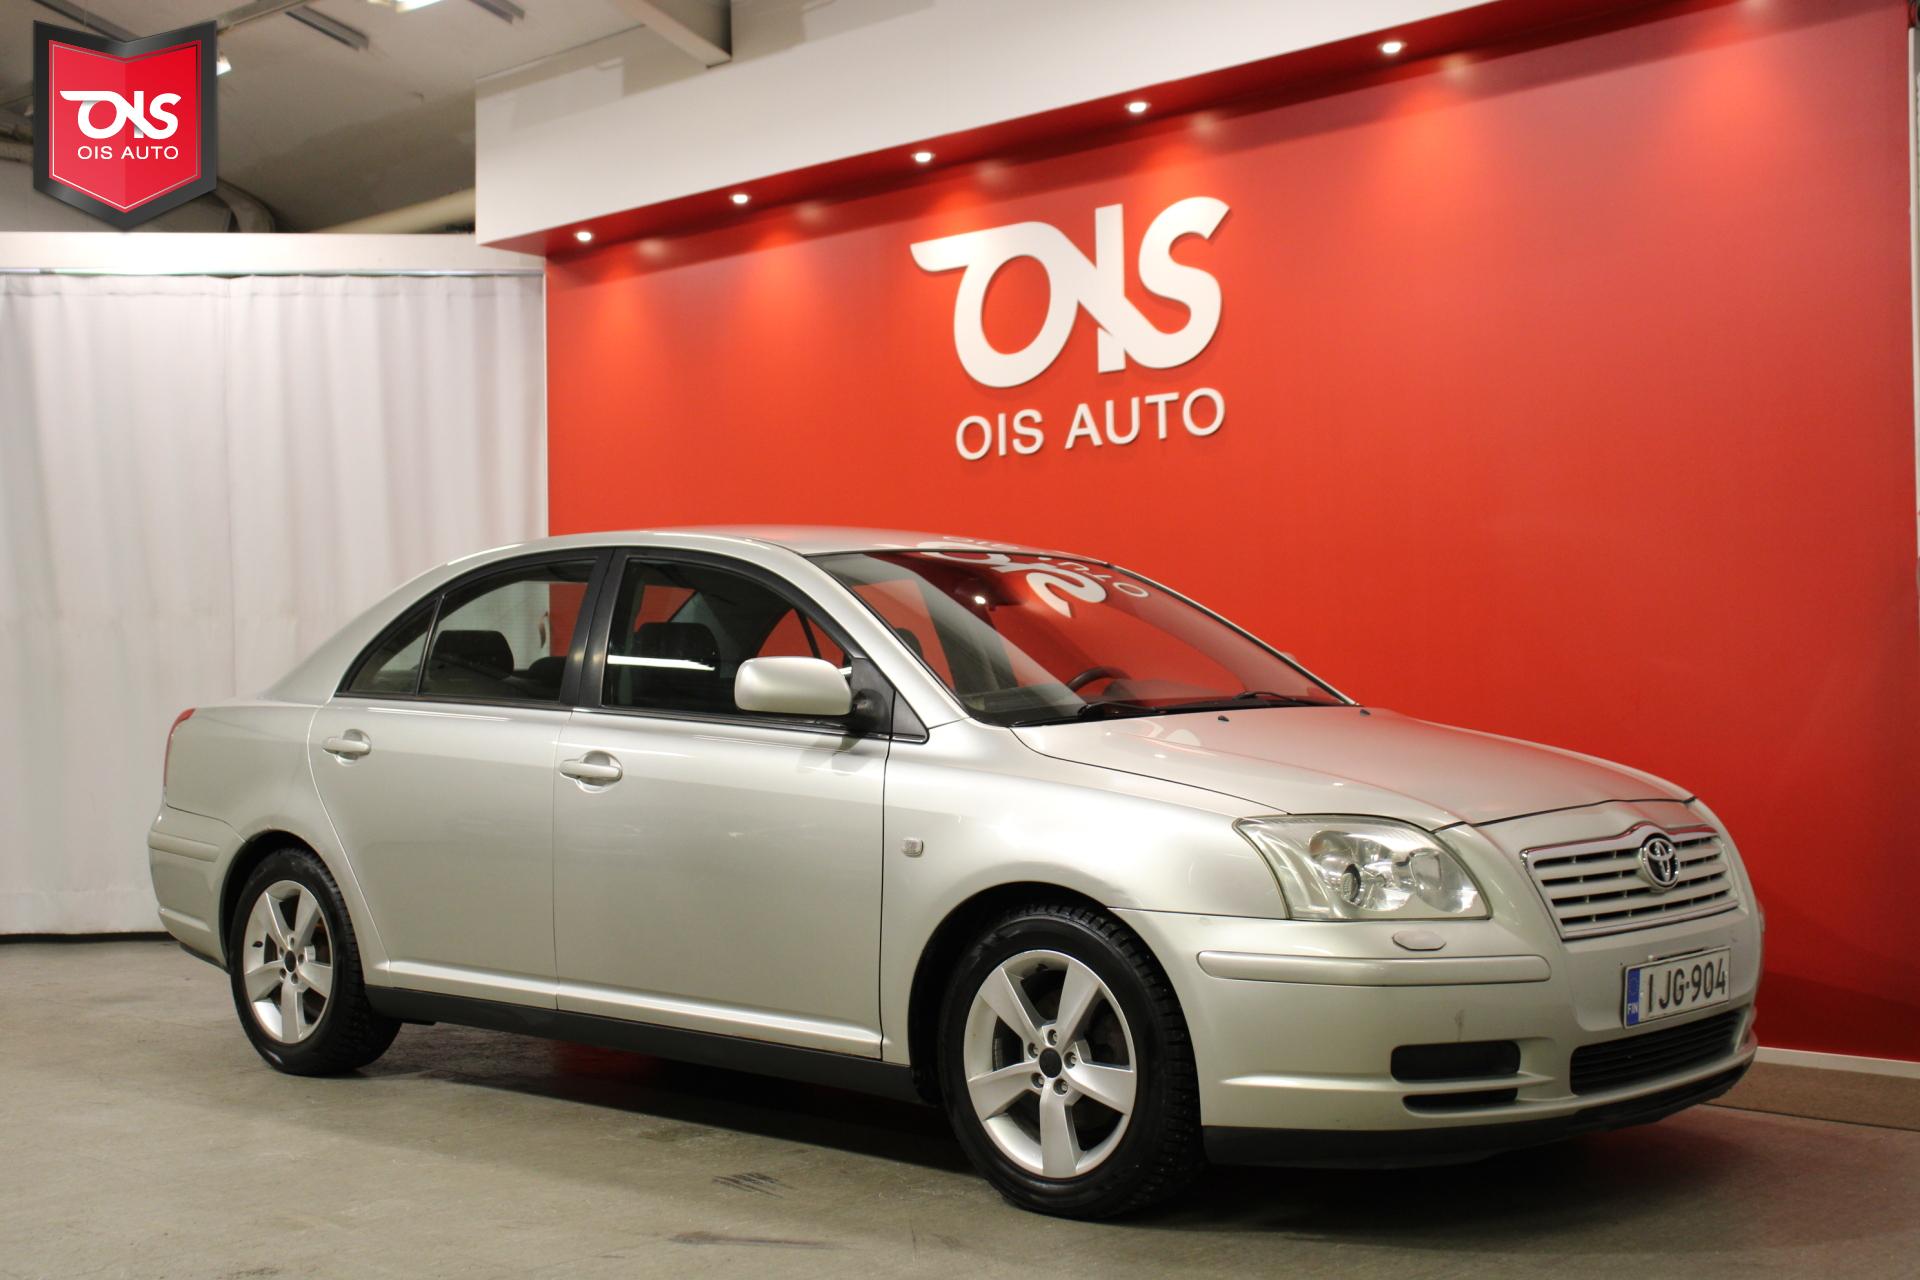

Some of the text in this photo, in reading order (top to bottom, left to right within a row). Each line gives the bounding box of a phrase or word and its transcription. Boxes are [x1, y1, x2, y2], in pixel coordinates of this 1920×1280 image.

[910, 196, 1230, 388] OIS
[955, 387, 1226, 461] OIS AUTO
[1647, 957, 1726, 1013] IJG-904
